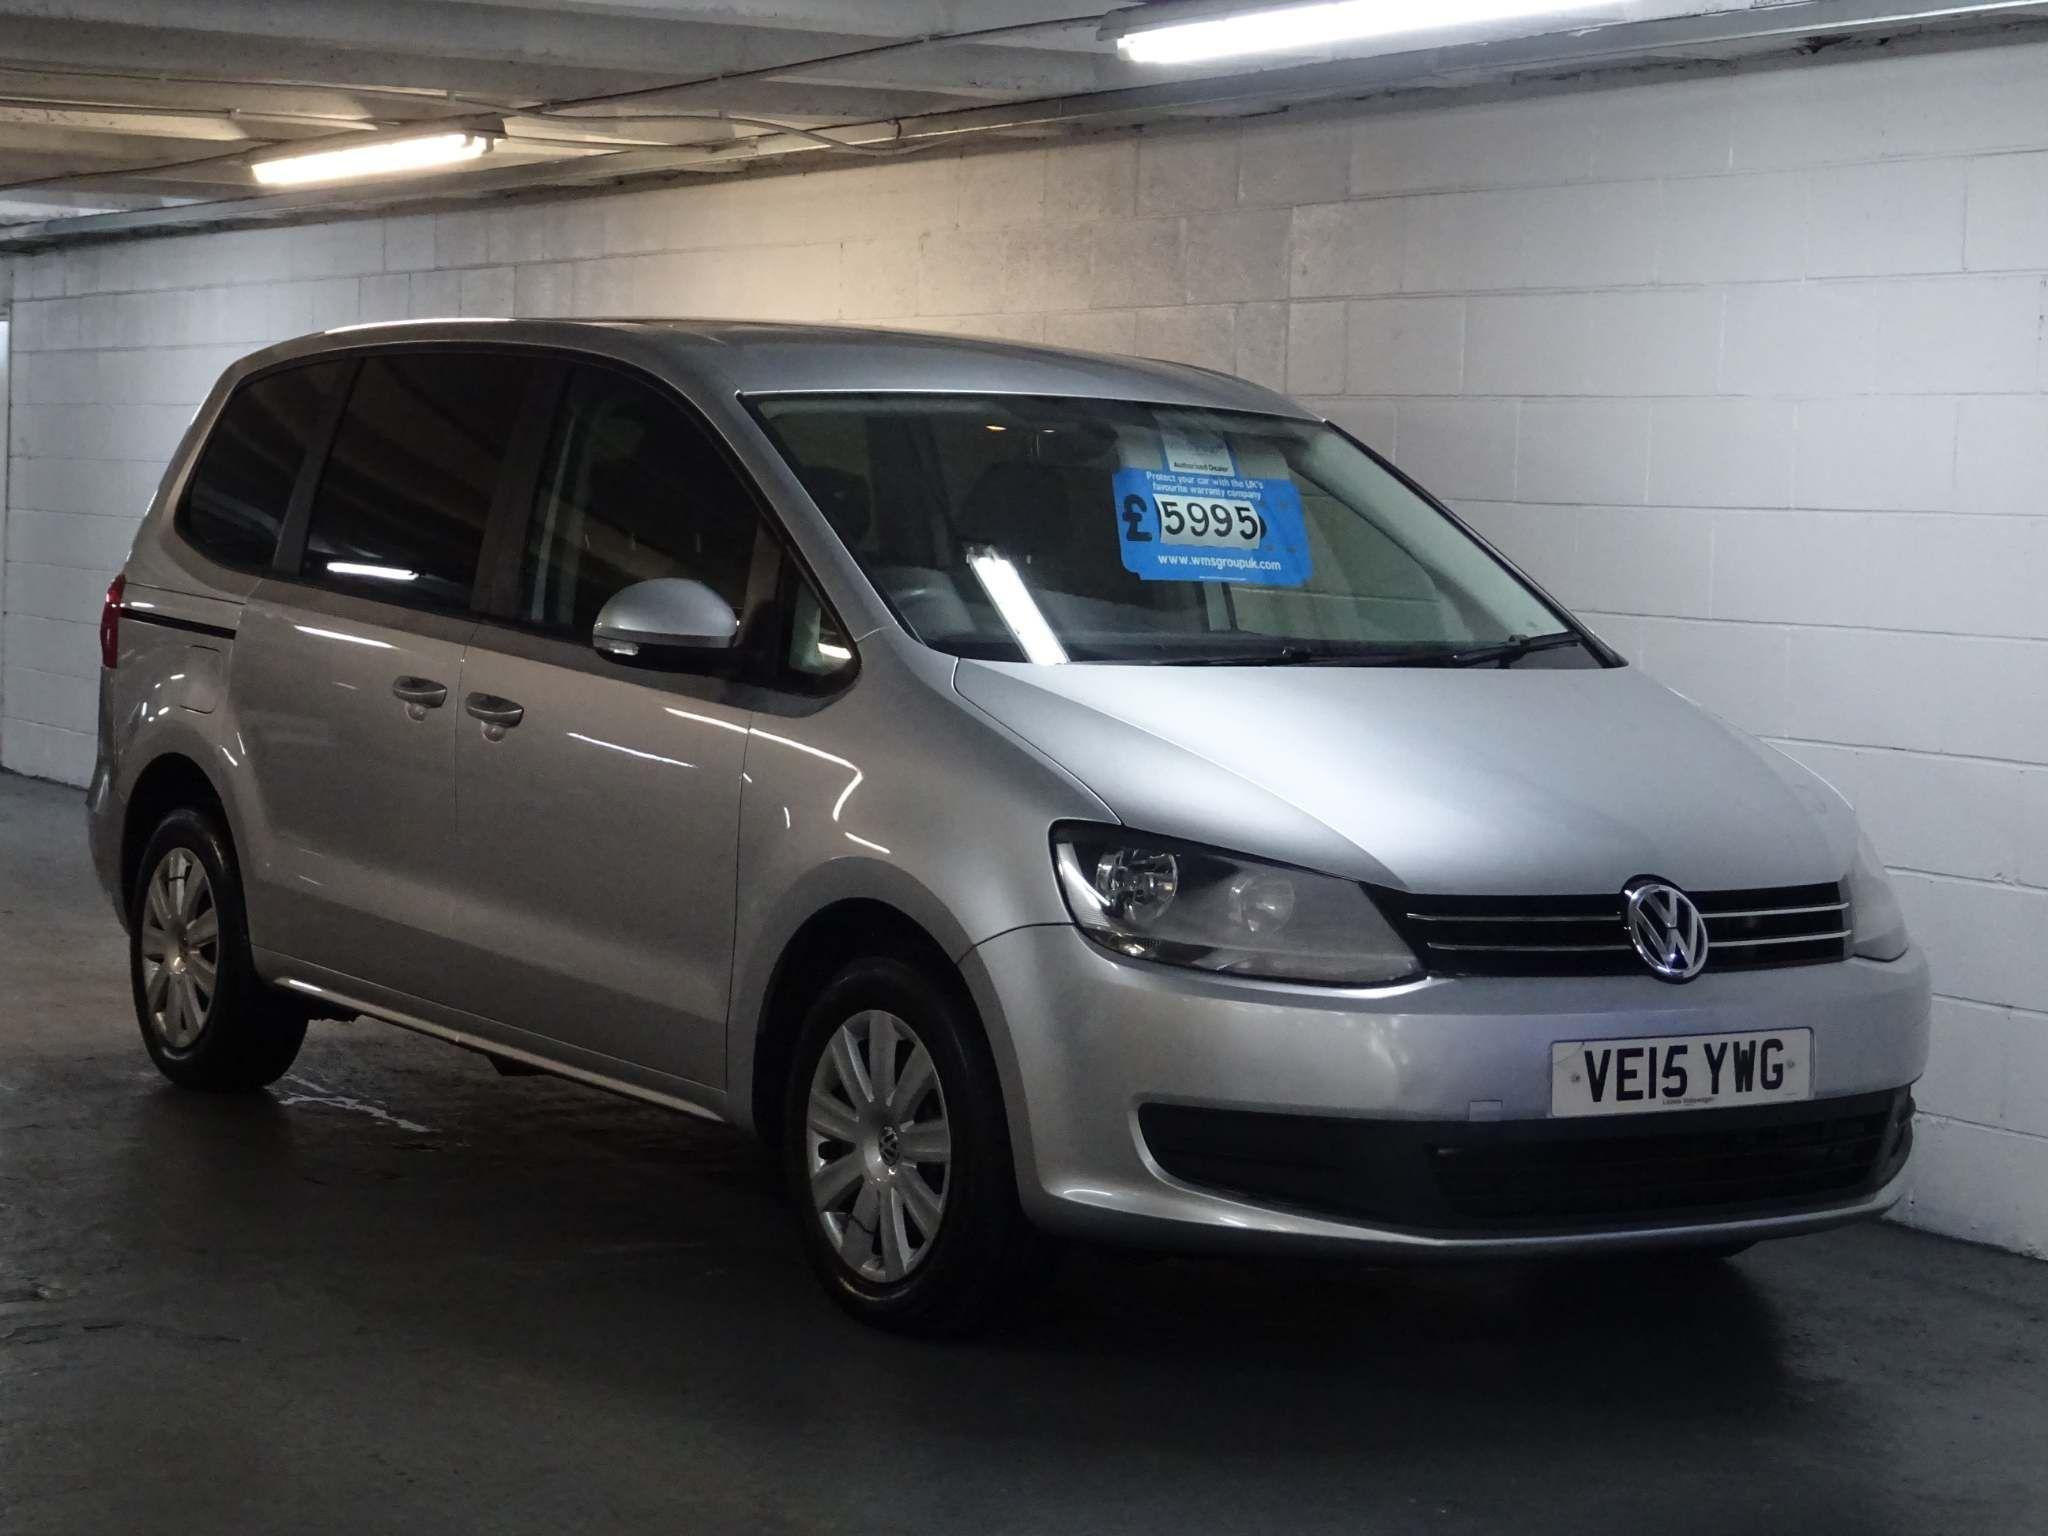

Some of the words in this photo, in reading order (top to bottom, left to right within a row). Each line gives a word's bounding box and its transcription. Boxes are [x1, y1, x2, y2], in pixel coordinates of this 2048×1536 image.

[1146, 472, 1176, 482] Protect
[1177, 475, 1194, 484] your
[1212, 477, 1230, 486] with
[1231, 478, 1244, 487] the
[1245, 479, 1264, 489] UK's
[1152, 482, 1188, 493] favourite
[1190, 486, 1225, 498] warranty
[1226, 489, 1262, 500] company
[1161, 501, 1259, 541] 5995
[1158, 554, 1281, 571] www.wmsgroupuk.com
[1584, 1045, 1688, 1103] VE15
[1704, 1038, 1785, 1095] YWG
